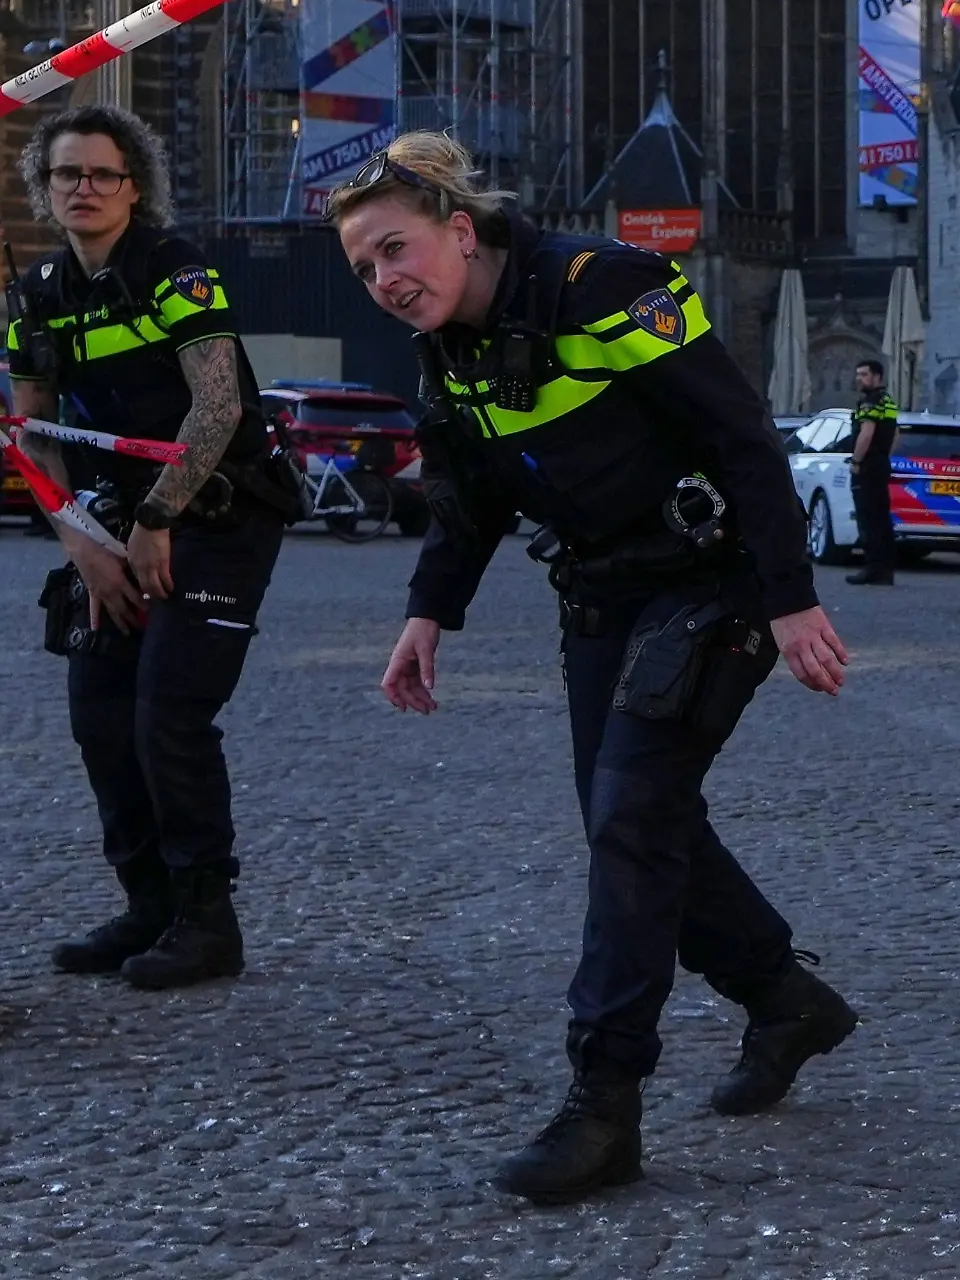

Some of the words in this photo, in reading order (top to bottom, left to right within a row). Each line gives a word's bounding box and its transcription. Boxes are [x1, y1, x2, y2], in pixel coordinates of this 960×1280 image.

[334, 142, 361, 167] 750
[877, 146, 901, 164] 750
[623, 212, 666, 226] Ontdek
[651, 226, 697, 239] Explore
[635, 295, 668, 318] POLITIE
